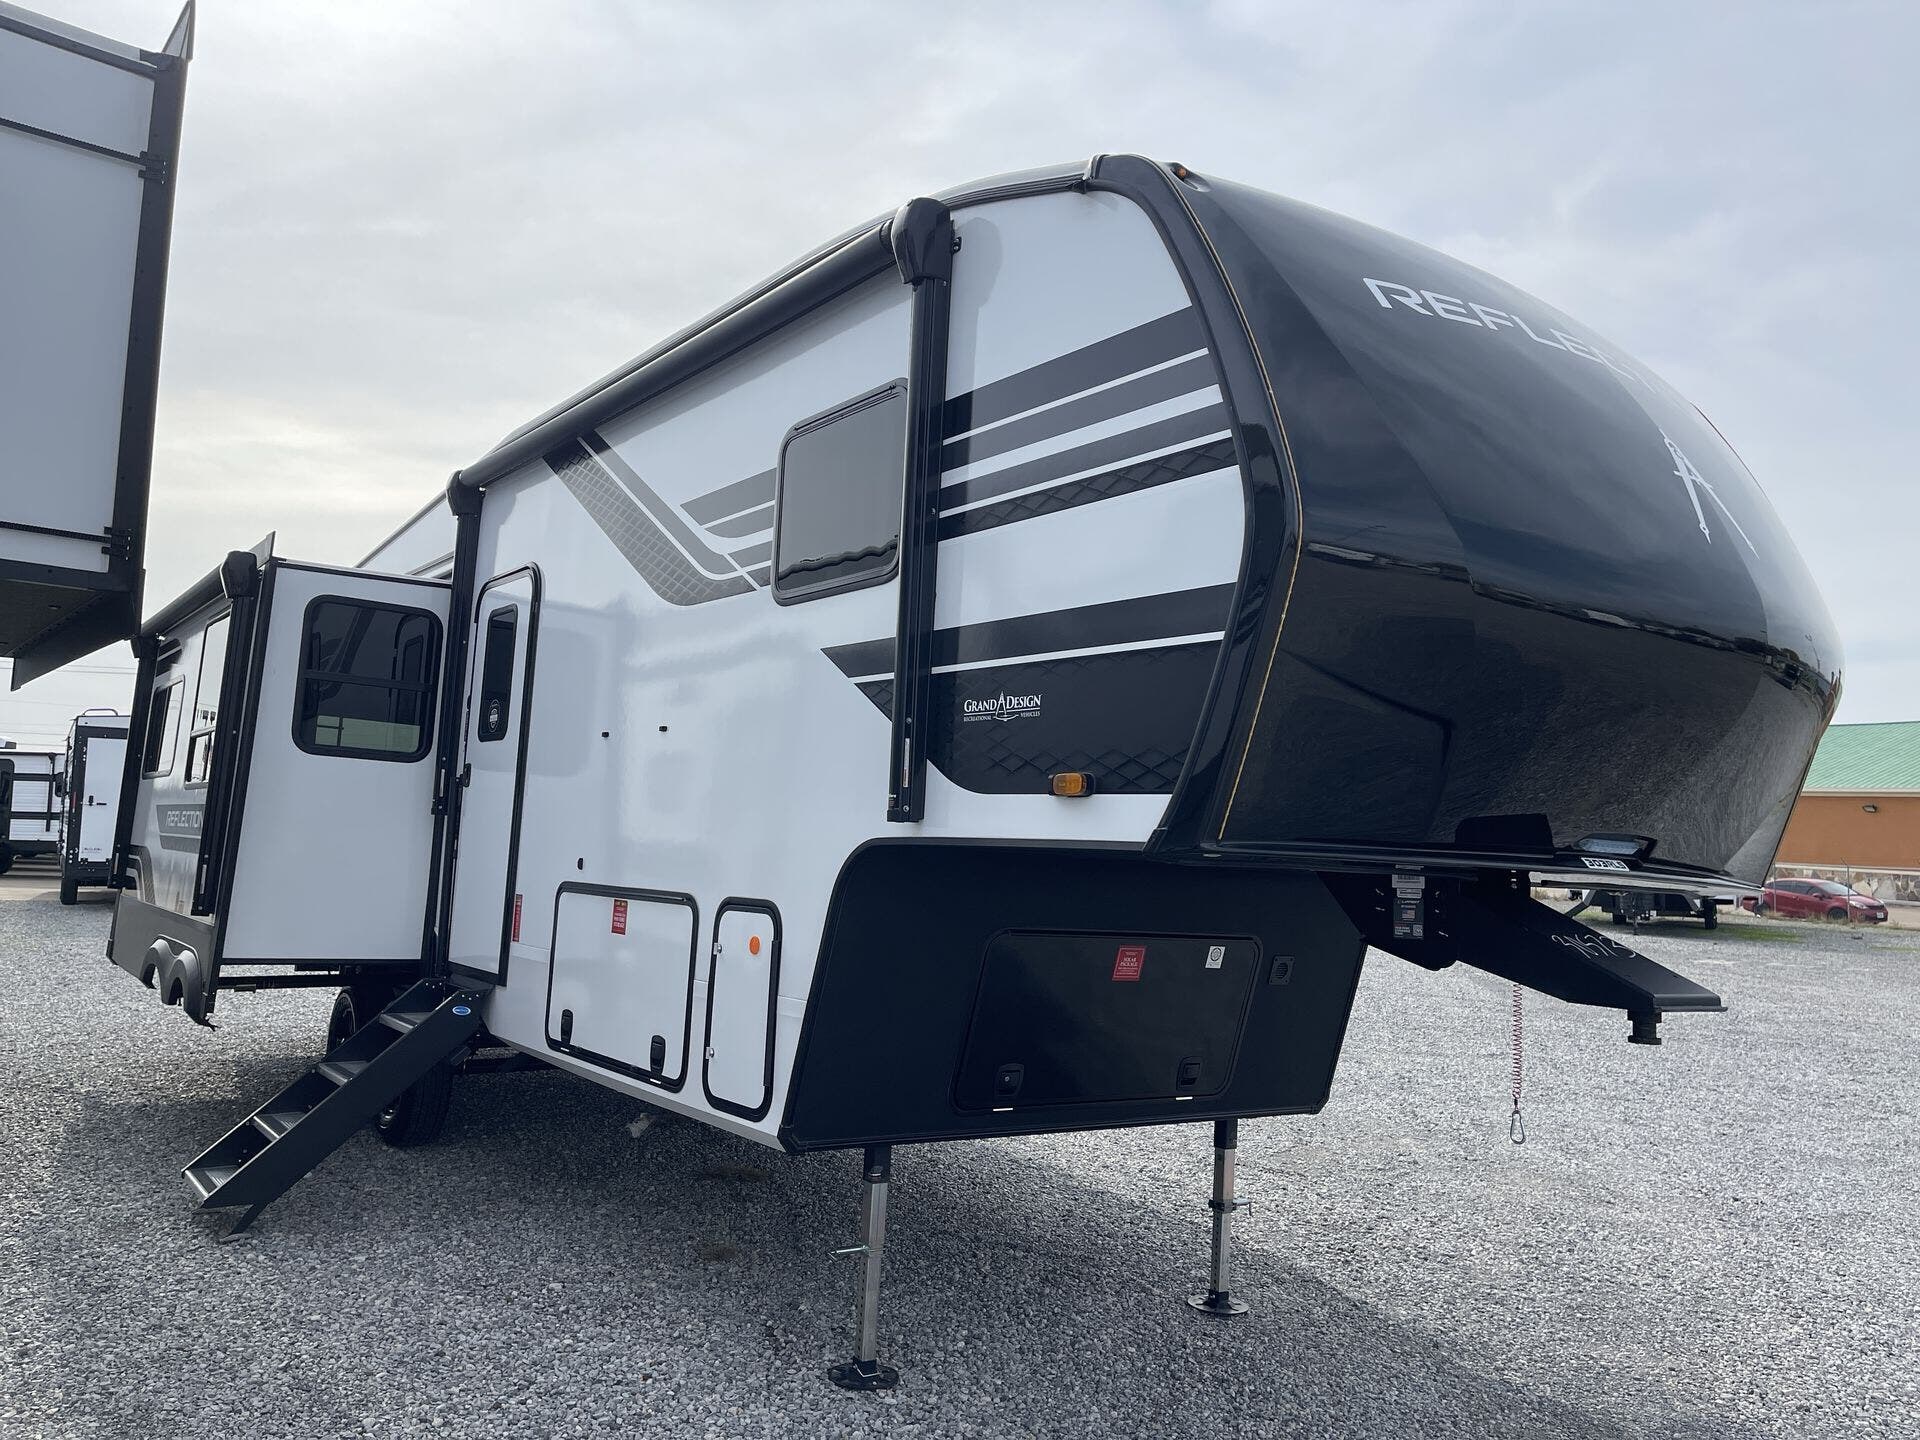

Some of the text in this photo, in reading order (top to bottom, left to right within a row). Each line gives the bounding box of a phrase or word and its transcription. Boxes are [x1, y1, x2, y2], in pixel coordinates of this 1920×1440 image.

[964, 694, 1043, 712] GRAND DESIGN
[1584, 858, 1627, 869] 303RLS
